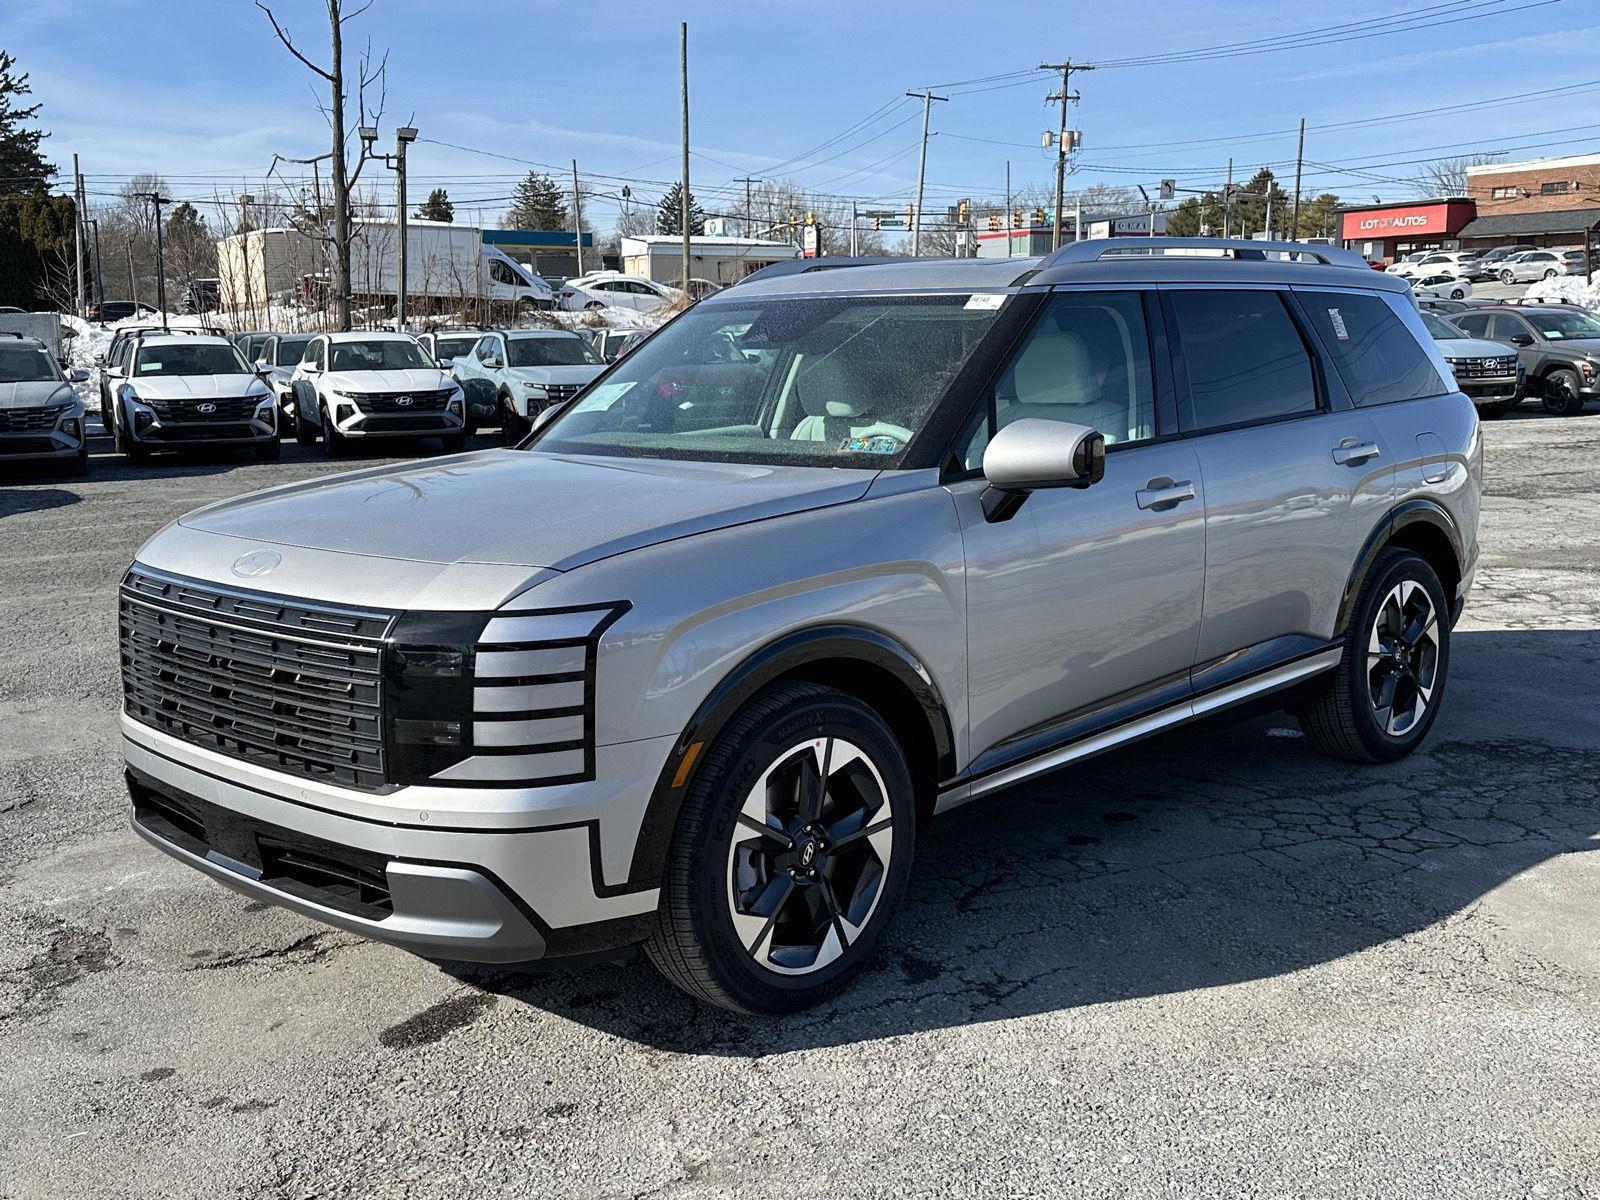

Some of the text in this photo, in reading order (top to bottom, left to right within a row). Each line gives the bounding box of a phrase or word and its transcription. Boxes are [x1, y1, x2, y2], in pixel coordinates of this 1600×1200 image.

[1360, 219, 1379, 229] LOT
[1392, 215, 1427, 227] AUTOS
[713, 757, 757, 842] KUMHO
